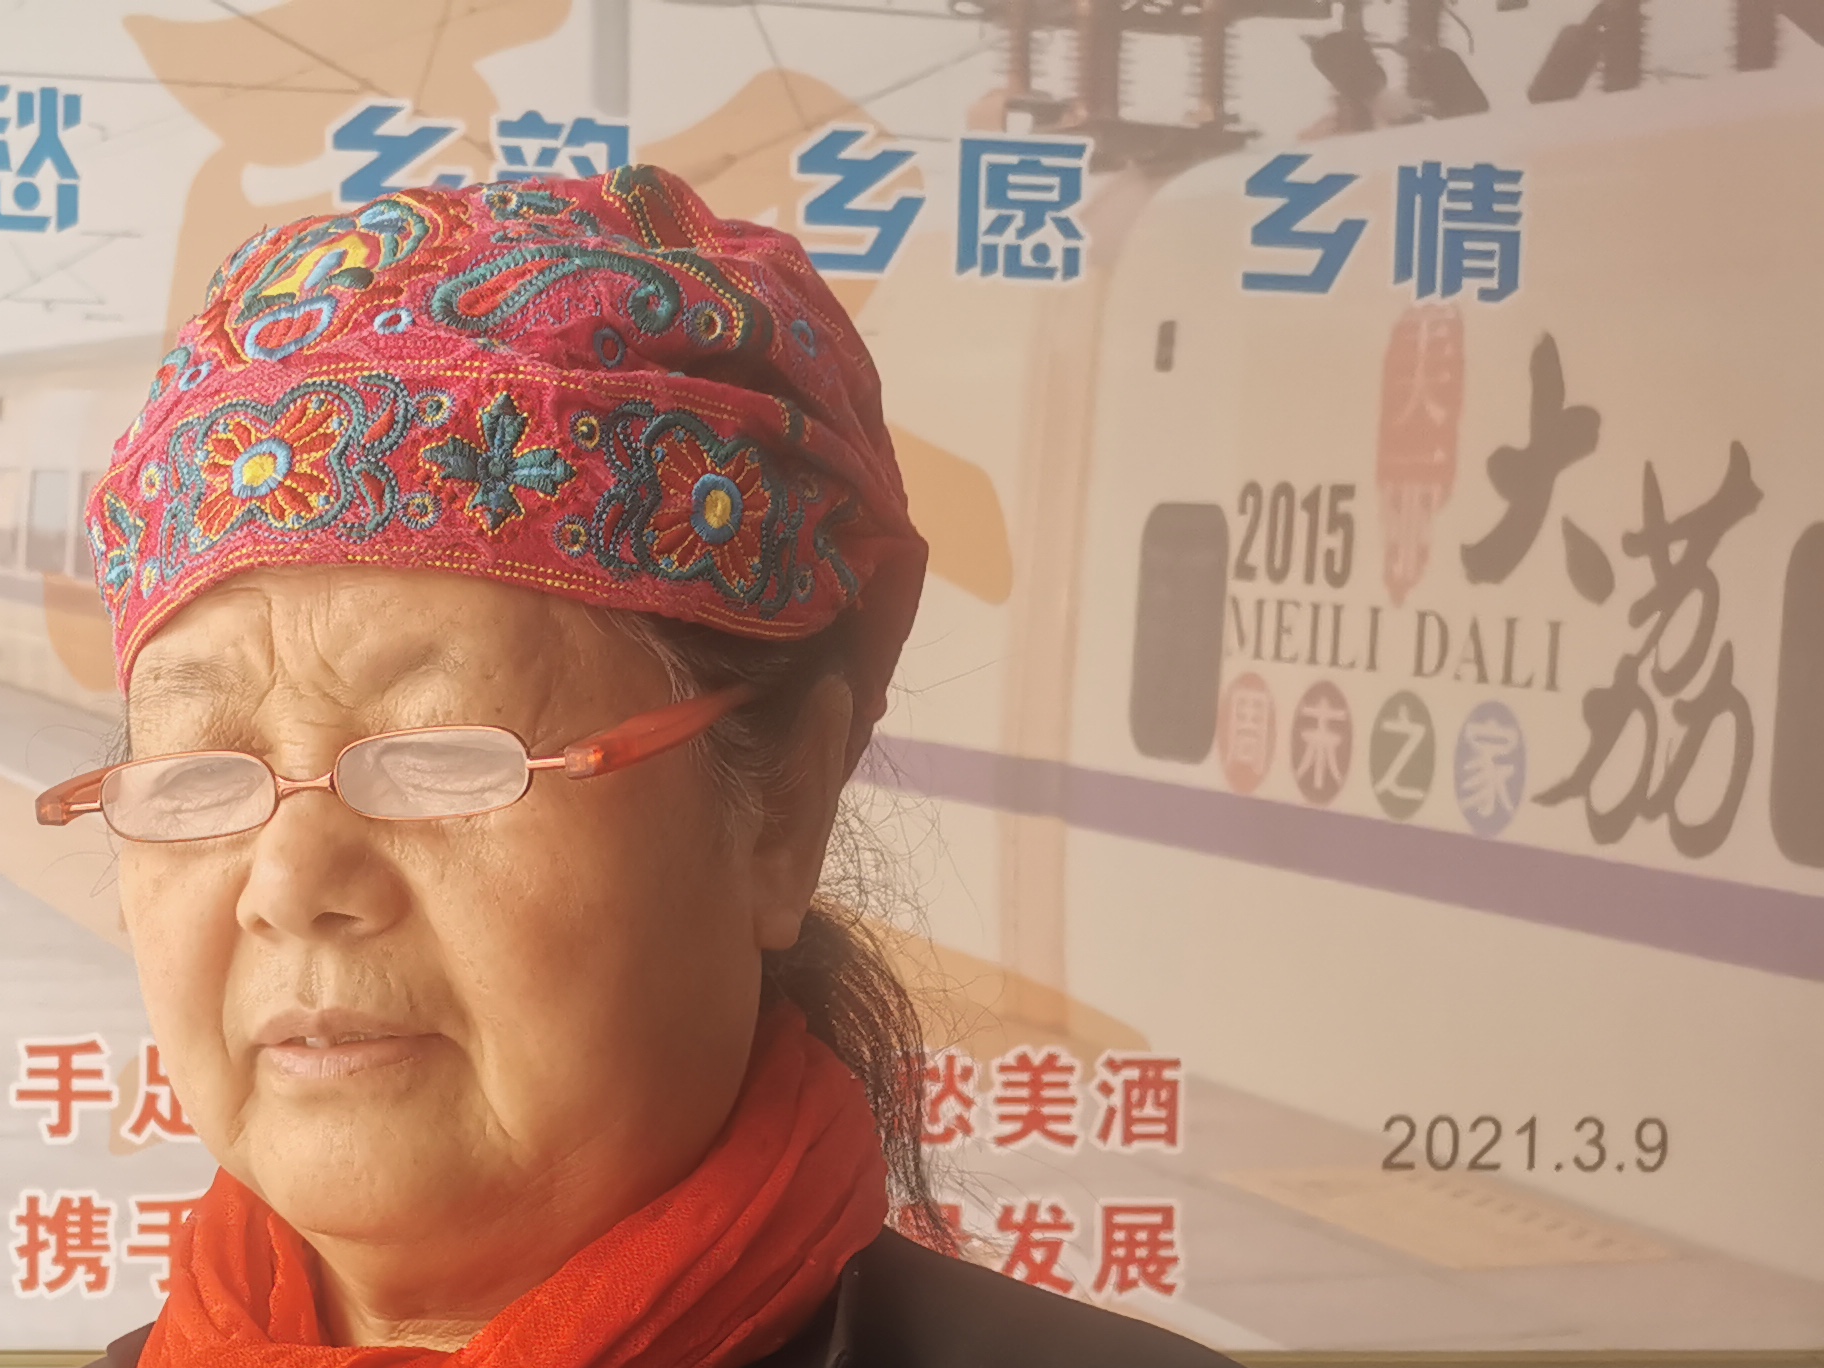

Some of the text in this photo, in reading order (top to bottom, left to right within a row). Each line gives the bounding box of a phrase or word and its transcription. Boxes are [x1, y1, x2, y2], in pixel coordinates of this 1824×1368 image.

[794, 129, 1087, 281] 乡愿
[1241, 154, 1525, 303] 乡情
[1234, 479, 1356, 588] 2015
[1226, 594, 1564, 693] MEILI DALI
[1224, 682, 1522, 826] 周末之家
[1381, 1114, 1668, 1173] 2021.3.9
[898, 1203, 1181, 1296] 发展
